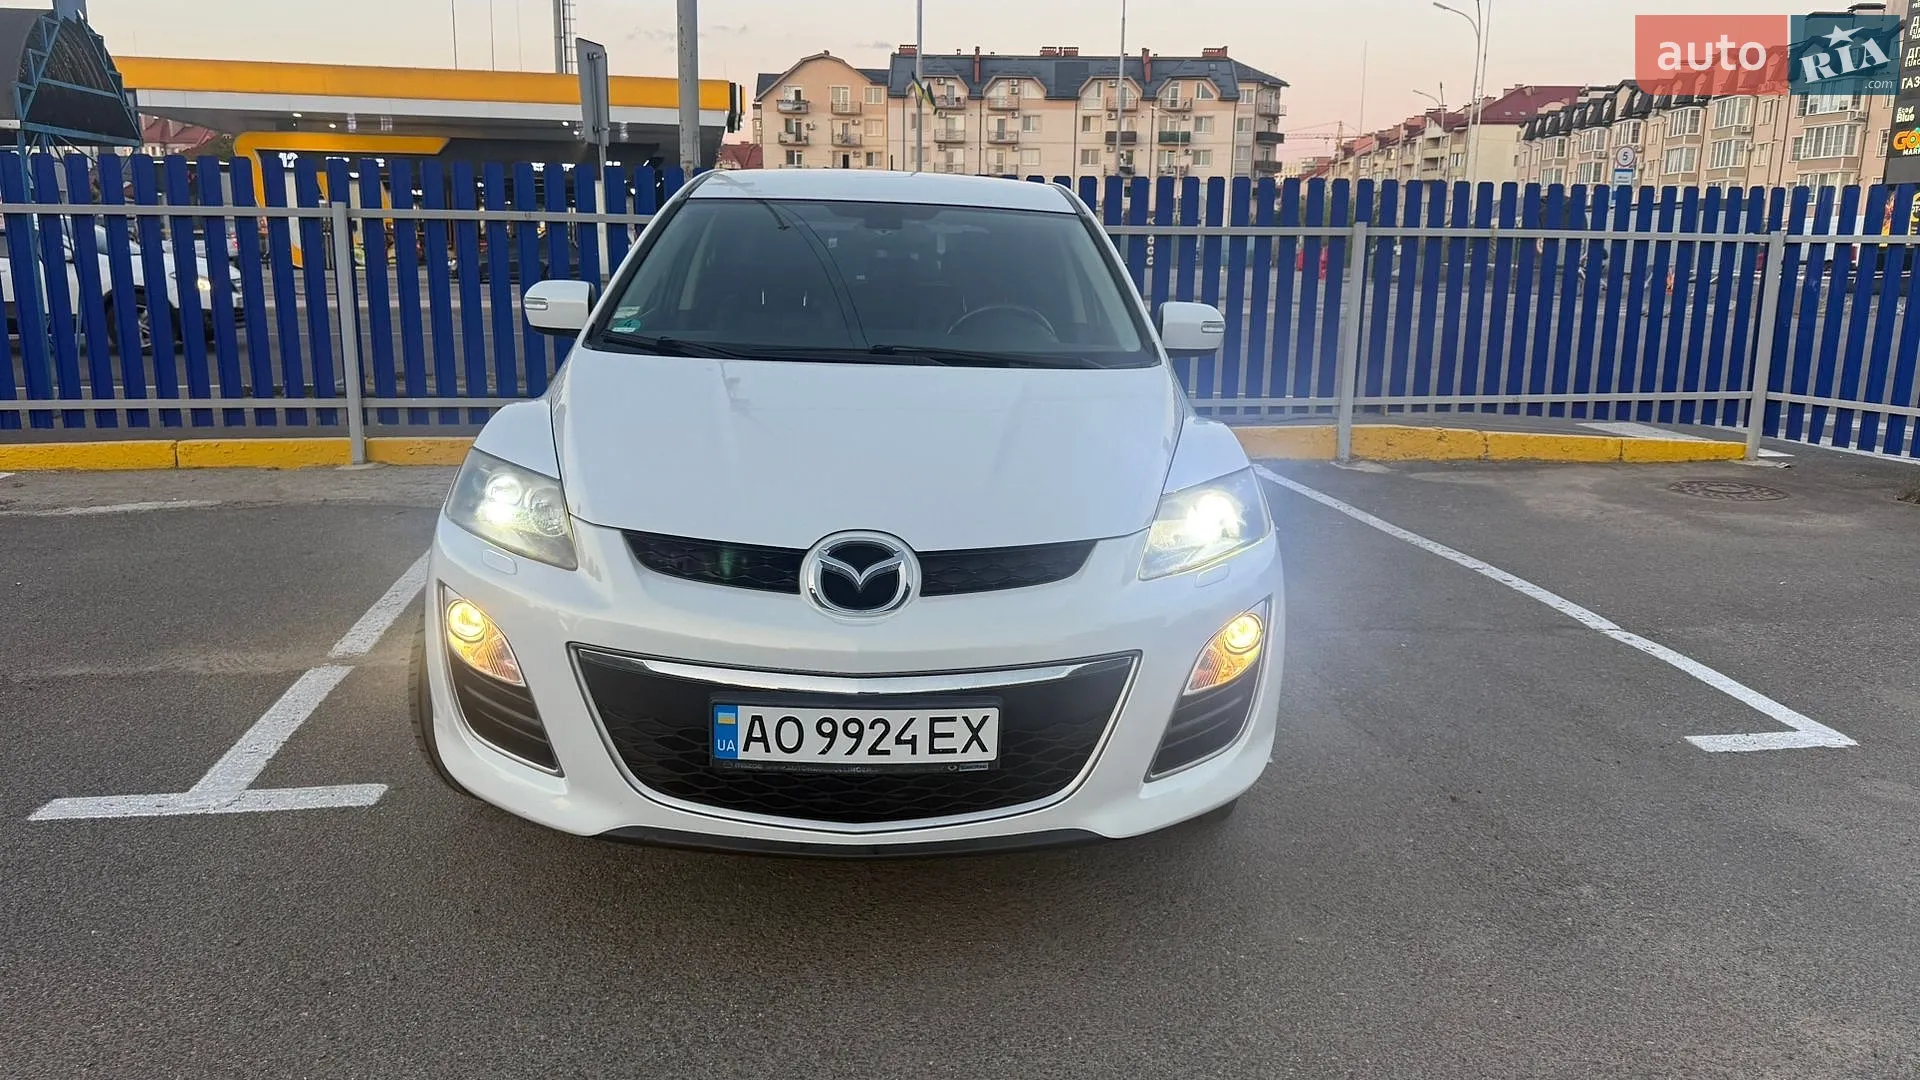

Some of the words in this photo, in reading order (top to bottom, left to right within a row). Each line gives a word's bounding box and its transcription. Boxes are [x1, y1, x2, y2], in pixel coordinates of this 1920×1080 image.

[1895, 112, 1915, 123] Blue
[1622, 151, 1629, 161] 5
[742, 715, 804, 754] AO
[815, 716, 918, 756] 9924
[928, 715, 990, 755] EX
[717, 739, 736, 752] UA
